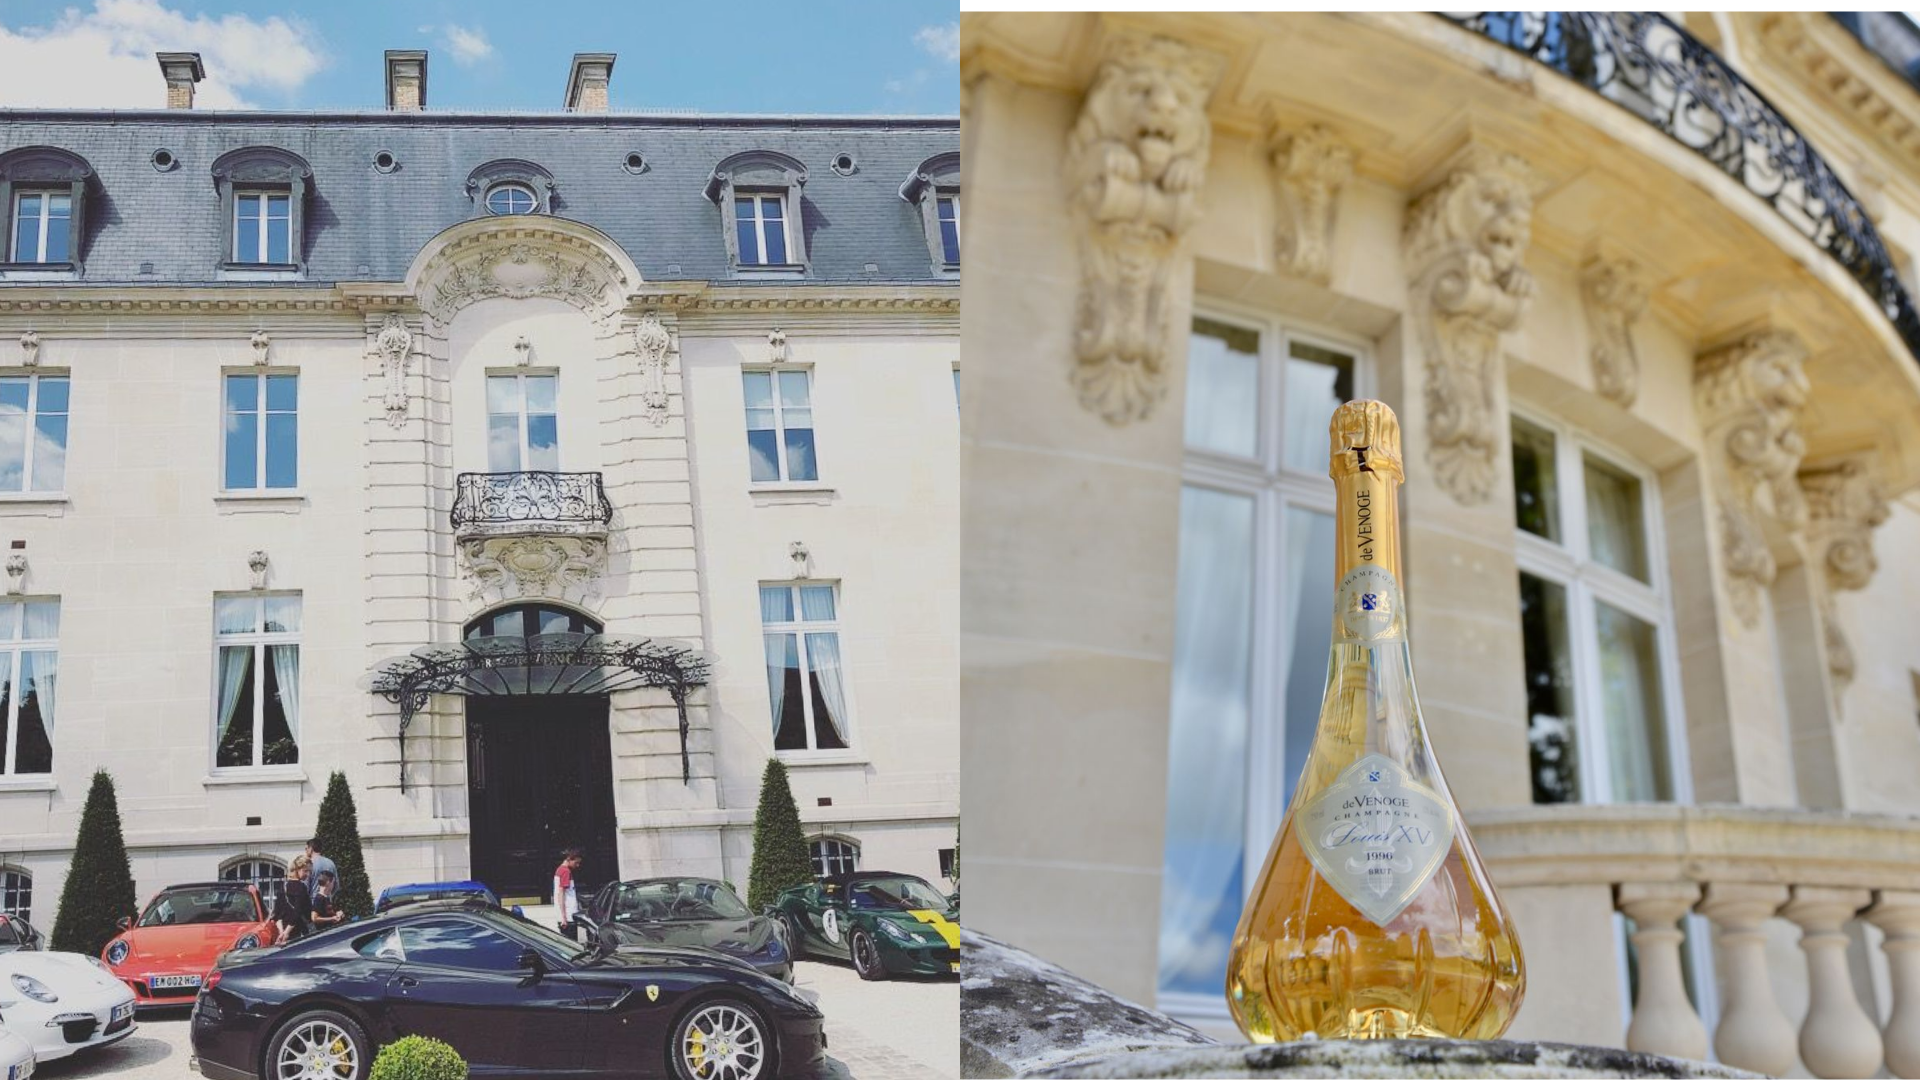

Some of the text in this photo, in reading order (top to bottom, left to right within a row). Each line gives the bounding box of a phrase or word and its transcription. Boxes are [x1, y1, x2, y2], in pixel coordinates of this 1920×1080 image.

[1334, 810, 1420, 822] CHAMPAGNE
[1322, 821, 1432, 851] Louis XV
[1366, 851, 1393, 861] 1996
[1368, 868, 1392, 876] BRUT
